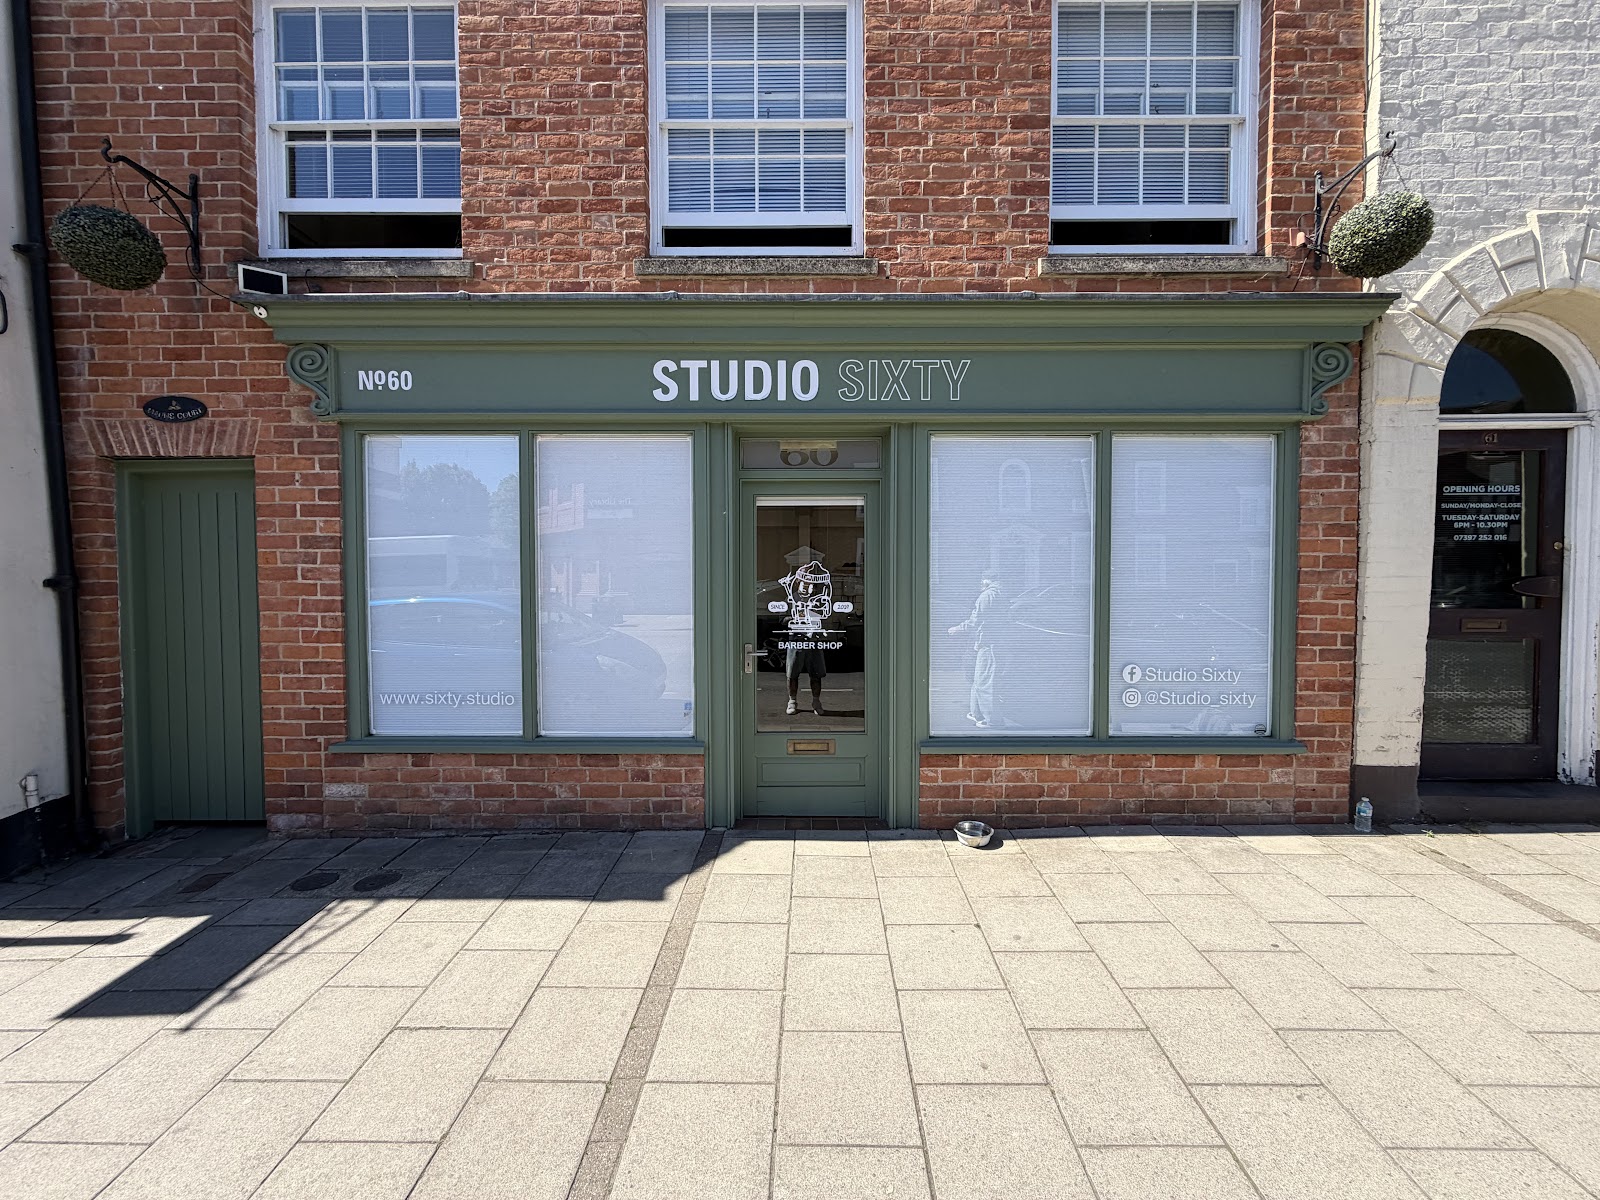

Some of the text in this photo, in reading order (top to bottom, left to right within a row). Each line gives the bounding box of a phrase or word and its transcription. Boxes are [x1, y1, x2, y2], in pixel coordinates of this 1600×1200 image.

[652, 359, 971, 402] STUDIO SIXTY
[1484, 433, 1499, 443] 61
[779, 442, 839, 467] 60
[1442, 485, 1521, 493] OPENING HOURS
[778, 641, 843, 650] BARBER SHOP
[1145, 667, 1242, 685] Studio Sixty
[379, 691, 515, 708] www.sixty.studio
[1145, 690, 1257, 708] @Studio_sixty
